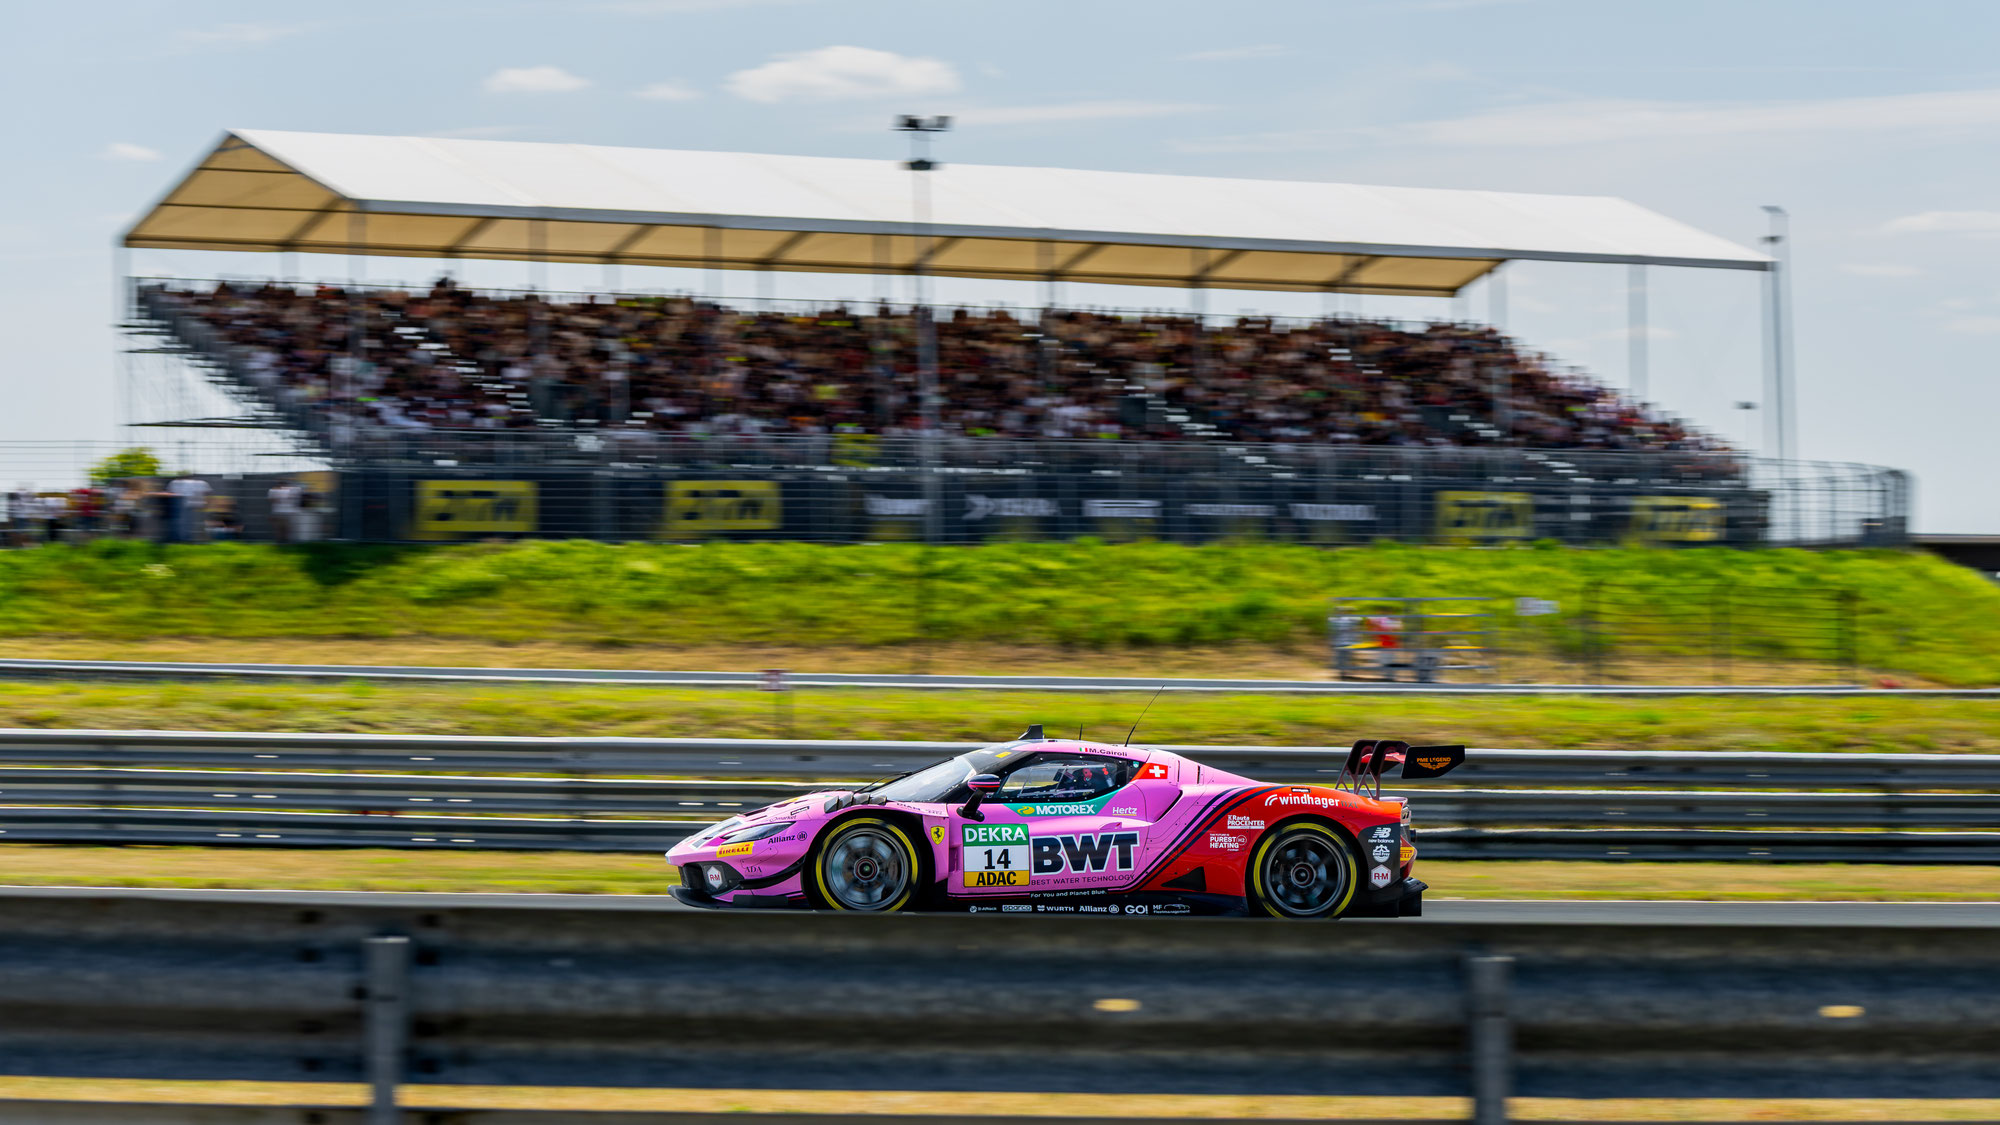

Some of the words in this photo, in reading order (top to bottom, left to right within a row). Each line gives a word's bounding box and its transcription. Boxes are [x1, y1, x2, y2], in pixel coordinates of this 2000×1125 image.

[1279, 793, 1340, 809] windhager
[1036, 804, 1096, 815] MOTOREX
[1112, 806, 1138, 815] Hertz
[767, 834, 796, 845] Allianz
[964, 826, 1027, 843] DEKRA
[983, 848, 1012, 870] 14
[1030, 830, 1140, 877] BWT
[976, 871, 1017, 886] ADAC
[1053, 877, 1080, 885] WATER
[1083, 874, 1136, 883] TECHNOLOGY
[1079, 904, 1108, 912] Allianz
[1124, 904, 1149, 914] GO!
